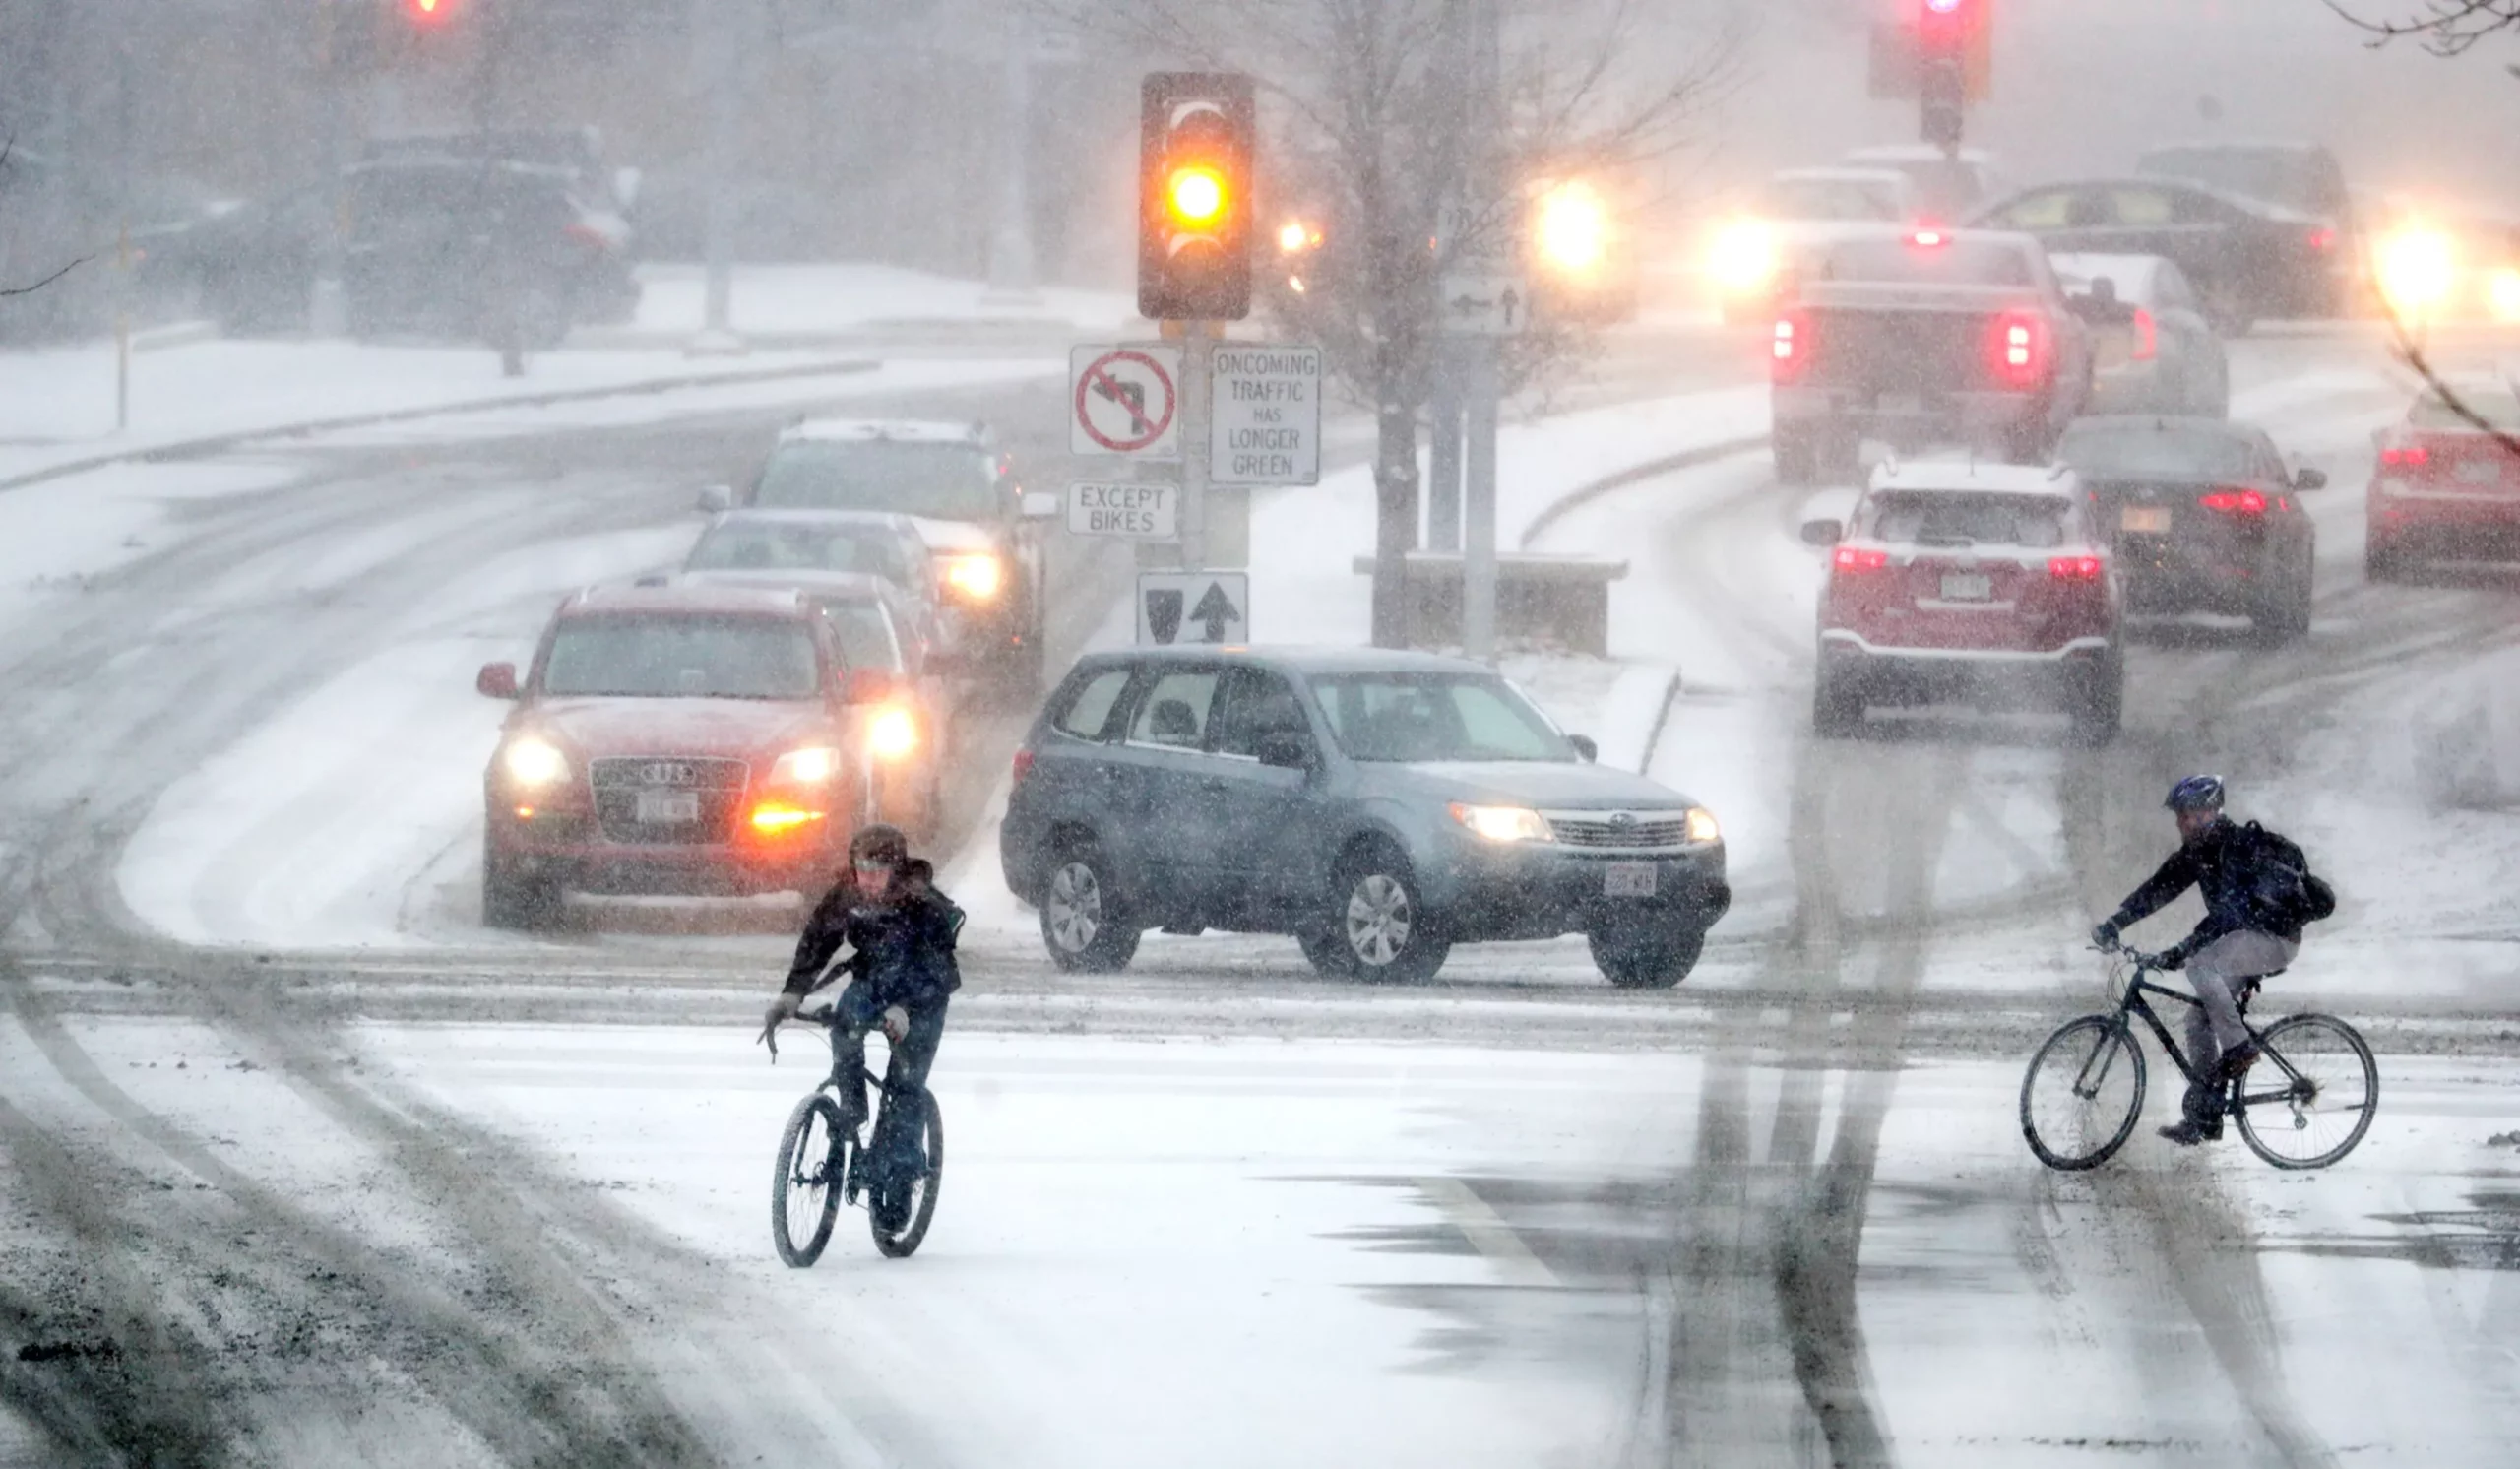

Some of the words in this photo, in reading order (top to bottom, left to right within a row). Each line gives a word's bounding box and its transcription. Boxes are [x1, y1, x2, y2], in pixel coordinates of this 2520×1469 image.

[1217, 353, 1316, 376] ONCOMING
[1231, 379, 1303, 402] TRAFFIC
[1253, 407, 1282, 422] HAS
[1228, 428, 1299, 449] LONGER
[1232, 454, 1292, 477] GREEN
[1080, 485, 1164, 510] EXCEPT
[1089, 510, 1155, 532] BIKES
